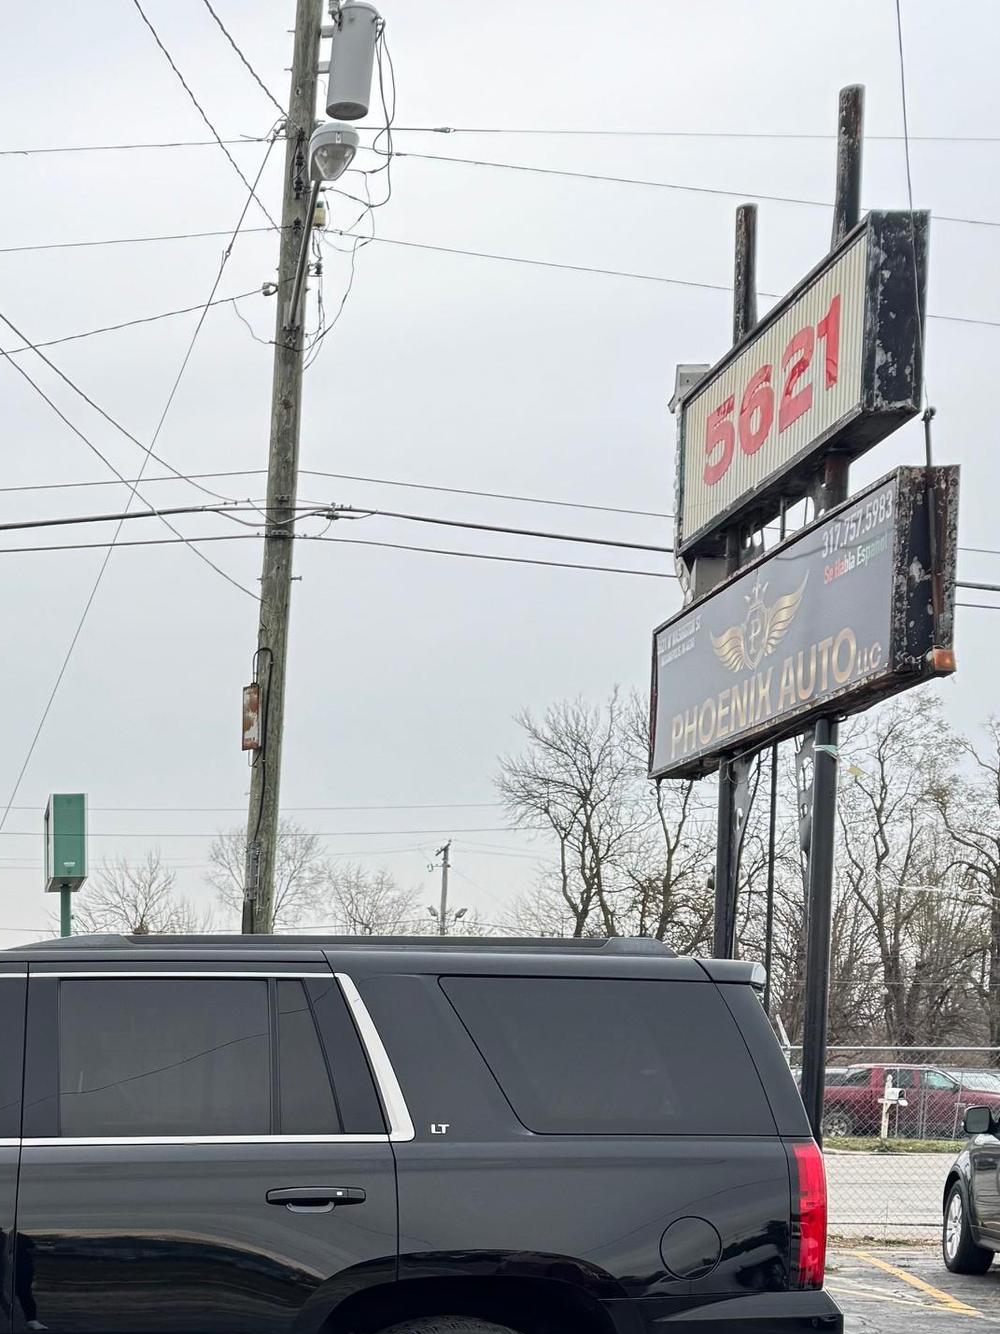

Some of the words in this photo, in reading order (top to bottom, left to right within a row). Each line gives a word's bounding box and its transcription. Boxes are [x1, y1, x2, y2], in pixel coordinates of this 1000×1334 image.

[703, 294, 841, 486] 5621
[822, 490, 893, 558] 317.757.5983
[671, 666, 774, 760] PHOENIX
[778, 627, 857, 710] AUTO
[857, 642, 882, 675] LLC
[431, 1124, 450, 1134] LT
